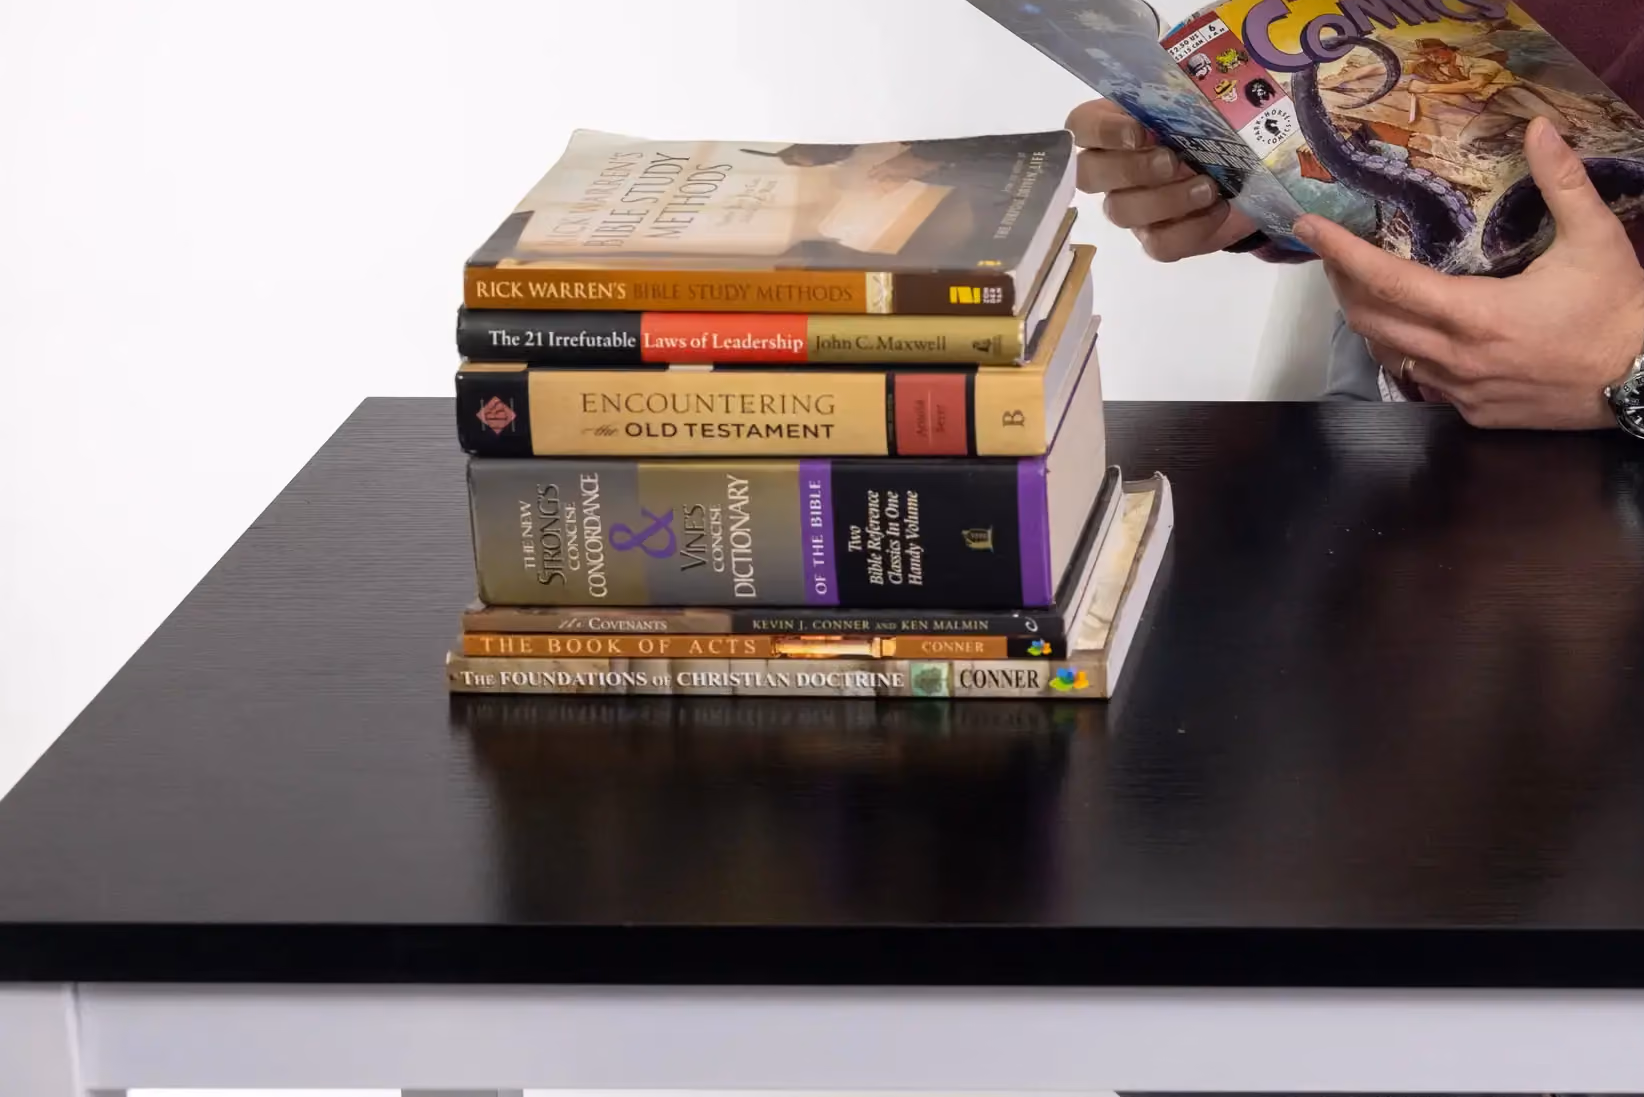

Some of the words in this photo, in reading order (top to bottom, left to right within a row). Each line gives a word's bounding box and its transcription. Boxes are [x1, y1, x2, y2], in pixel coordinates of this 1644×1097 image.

[1208, 24, 1217, 32] 6
[583, 208, 650, 247] BIBLE
[620, 152, 690, 204] STUDY
[645, 163, 733, 239] METHODS
[476, 281, 523, 299] RICK
[528, 281, 627, 300] WARREN'S
[633, 283, 681, 301] BIBLE
[688, 283, 752, 301] STUDY
[756, 285, 853, 302] METHODS
[488, 330, 520, 347] The
[524, 331, 543, 347] 21
[549, 331, 637, 349] Irrefutable
[644, 333, 687, 350] Laws
[690, 332, 708, 350] of
[711, 332, 804, 353] Leadership
[816, 335, 852, 353] John
[856, 335, 875, 351] C.
[877, 335, 947, 352] Maxwell
[581, 393, 835, 415] ENCOUNTERING
[581, 424, 621, 439] the
[625, 422, 678, 438] OLD
[684, 423, 835, 440] TESTAMENT
[518, 500, 532, 538] NEW
[808, 480, 823, 528] BIBLE
[884, 491, 900, 519] One
[903, 490, 920, 541] Volume
[537, 483, 568, 587] STRONG'S
[564, 502, 581, 571] CONCISE
[580, 472, 609, 598] CONCORDANCE
[608, 507, 678, 559] &
[726, 474, 757, 598] DICTIONARY
[865, 490, 882, 551] Reference
[885, 520, 901, 538] In
[679, 504, 707, 572] VINE'S
[709, 504, 725, 572] CONCISE
[811, 534, 825, 568] THE
[848, 525, 863, 552] Two
[522, 539, 536, 570] THE
[867, 553, 884, 586] Bible
[887, 539, 903, 585] Classics
[908, 542, 925, 586] Handy
[814, 575, 828, 595] OF
[752, 619, 795, 630] KEVIN
[798, 619, 806, 631] J.
[812, 619, 871, 630] CONNER
[876, 621, 897, 631] AND
[901, 619, 928, 631] KEN
[932, 620, 989, 631] MALMIN
[480, 637, 533, 653] THE
[549, 638, 622, 654] BOOK
[638, 638, 672, 654] OF
[688, 638, 757, 655] ACTS
[921, 641, 985, 654] CONNER
[460, 671, 496, 686] THE
[500, 671, 648, 687] FOUNDATIONS
[677, 671, 790, 688] CHRISTIAN
[796, 672, 905, 689] DOCTRINE
[960, 668, 1041, 690] CONNER
